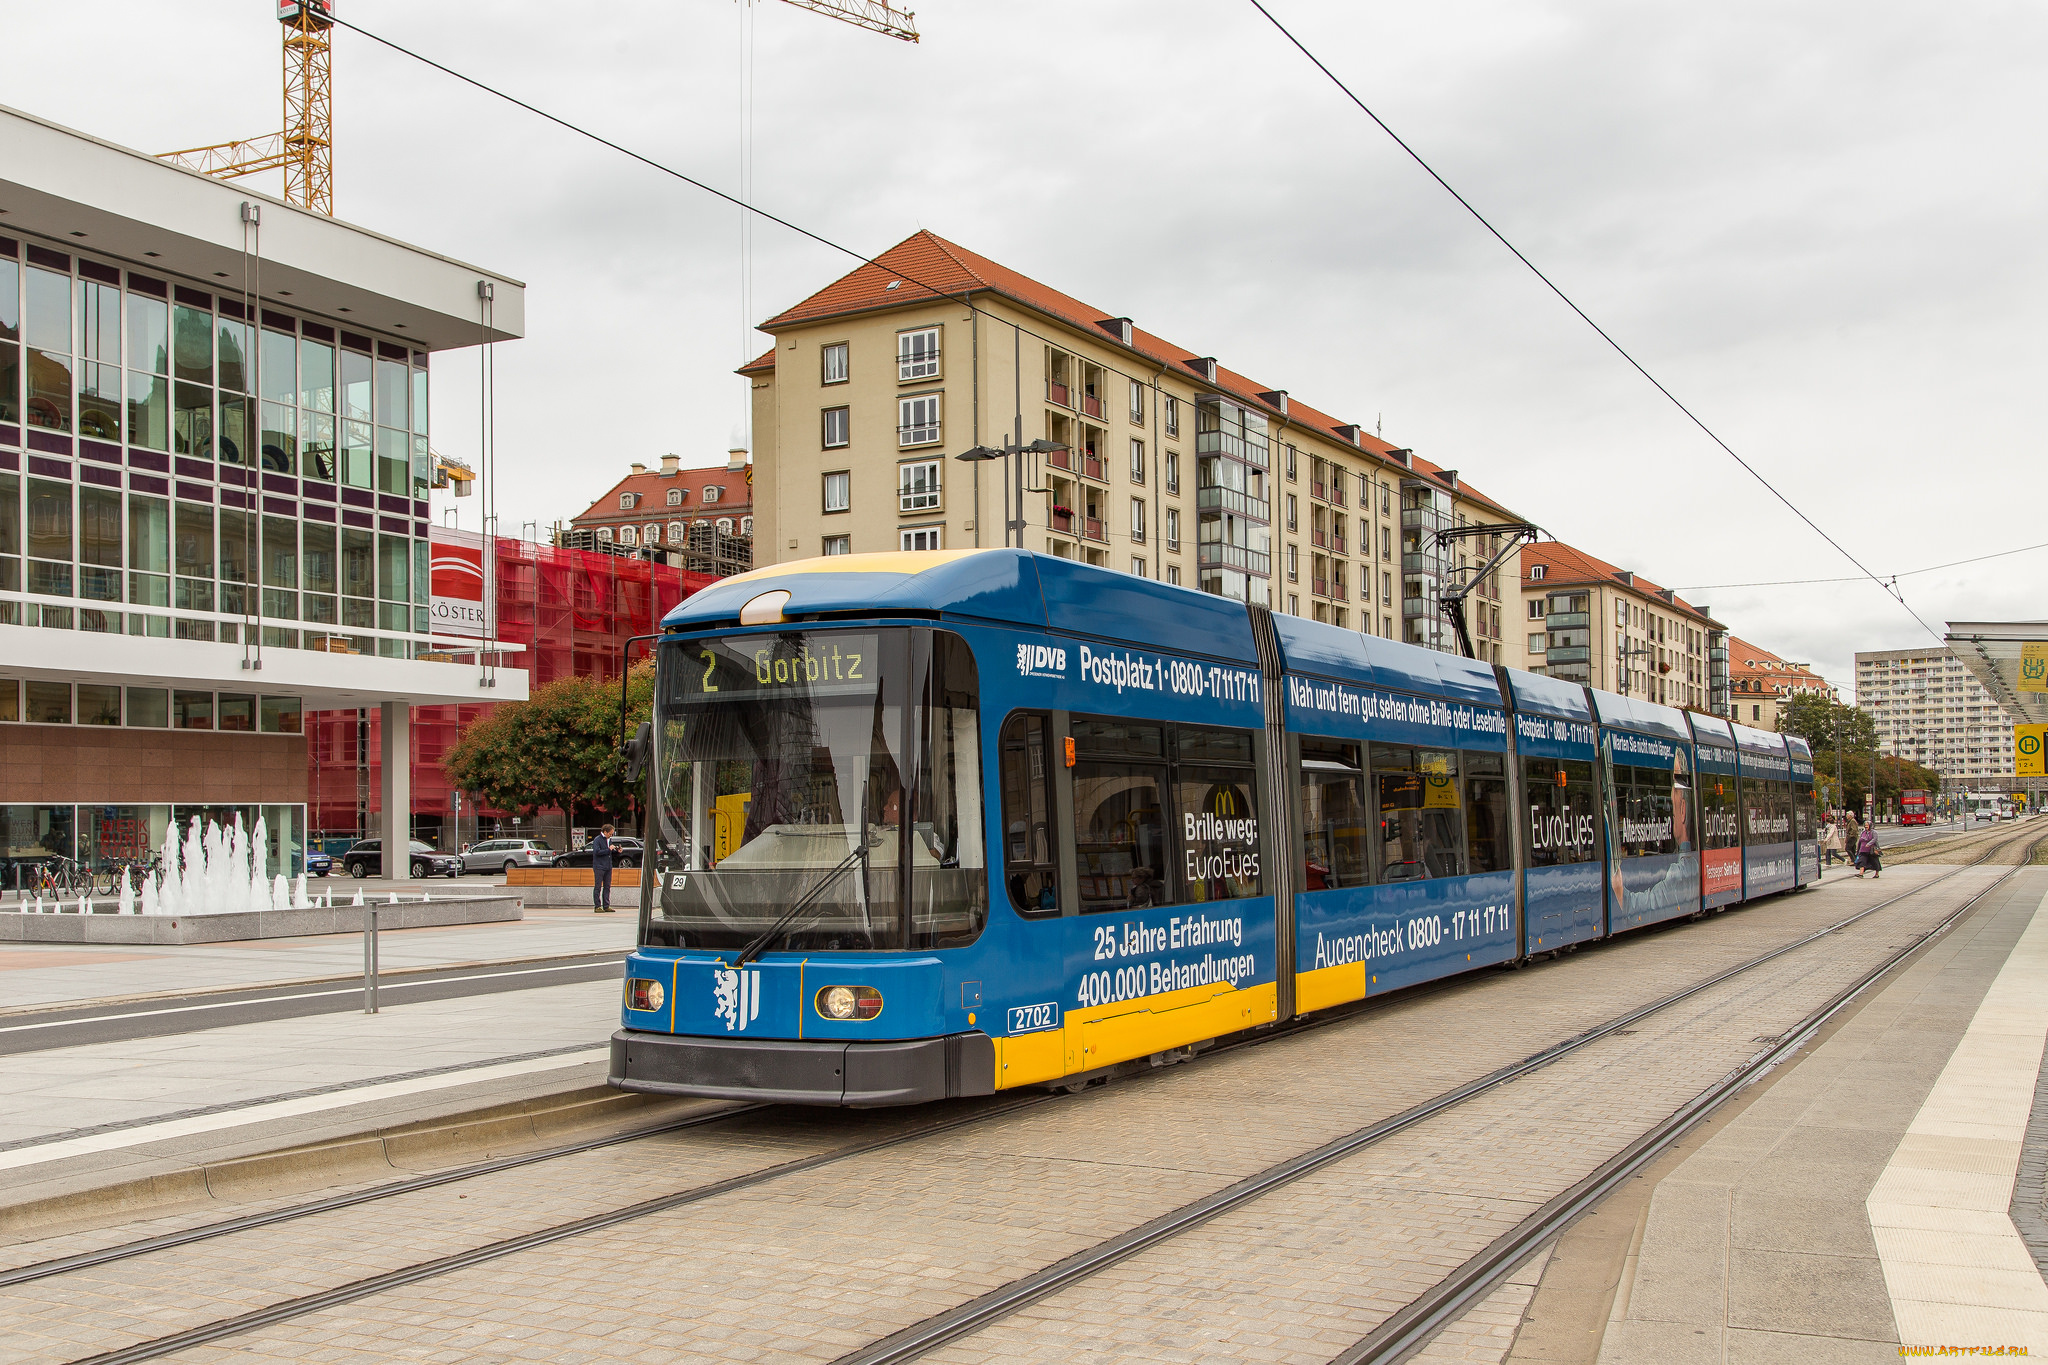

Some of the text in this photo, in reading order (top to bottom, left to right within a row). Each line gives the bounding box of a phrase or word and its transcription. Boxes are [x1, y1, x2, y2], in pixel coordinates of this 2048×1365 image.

[431, 602, 484, 622] KÖSTER
[700, 645, 864, 692] 2 Gorbitz
[1035, 646, 1066, 670] DVB
[1080, 646, 1154, 694] Postplatz
[1290, 676, 1506, 734] Nah und fern gut sehen ohne Brille oder Lesebrille
[1518, 714, 1546, 742] Postplatz
[1612, 733, 1629, 751] Warten
[1629, 736, 1637, 752] Sie
[1637, 738, 1648, 754] nicht
[101, 819, 148, 832] WERK
[101, 833, 148, 846] BUND
[1184, 812, 1258, 846] Brille weg:
[1531, 805, 1594, 856] EuroEyes
[1704, 806, 1736, 848] EuroEyes
[101, 846, 148, 858] STADT
[1187, 848, 1260, 884] EuroEyes
[674, 878, 684, 888] 29
[1094, 914, 1242, 960] 25 Jahre Erfahrung
[1315, 920, 1404, 970] Augencheck
[1408, 915, 1440, 950] 0800
[1078, 954, 1254, 1008] 400.000 Behandlungen
[1016, 1006, 1050, 1030] 2702
